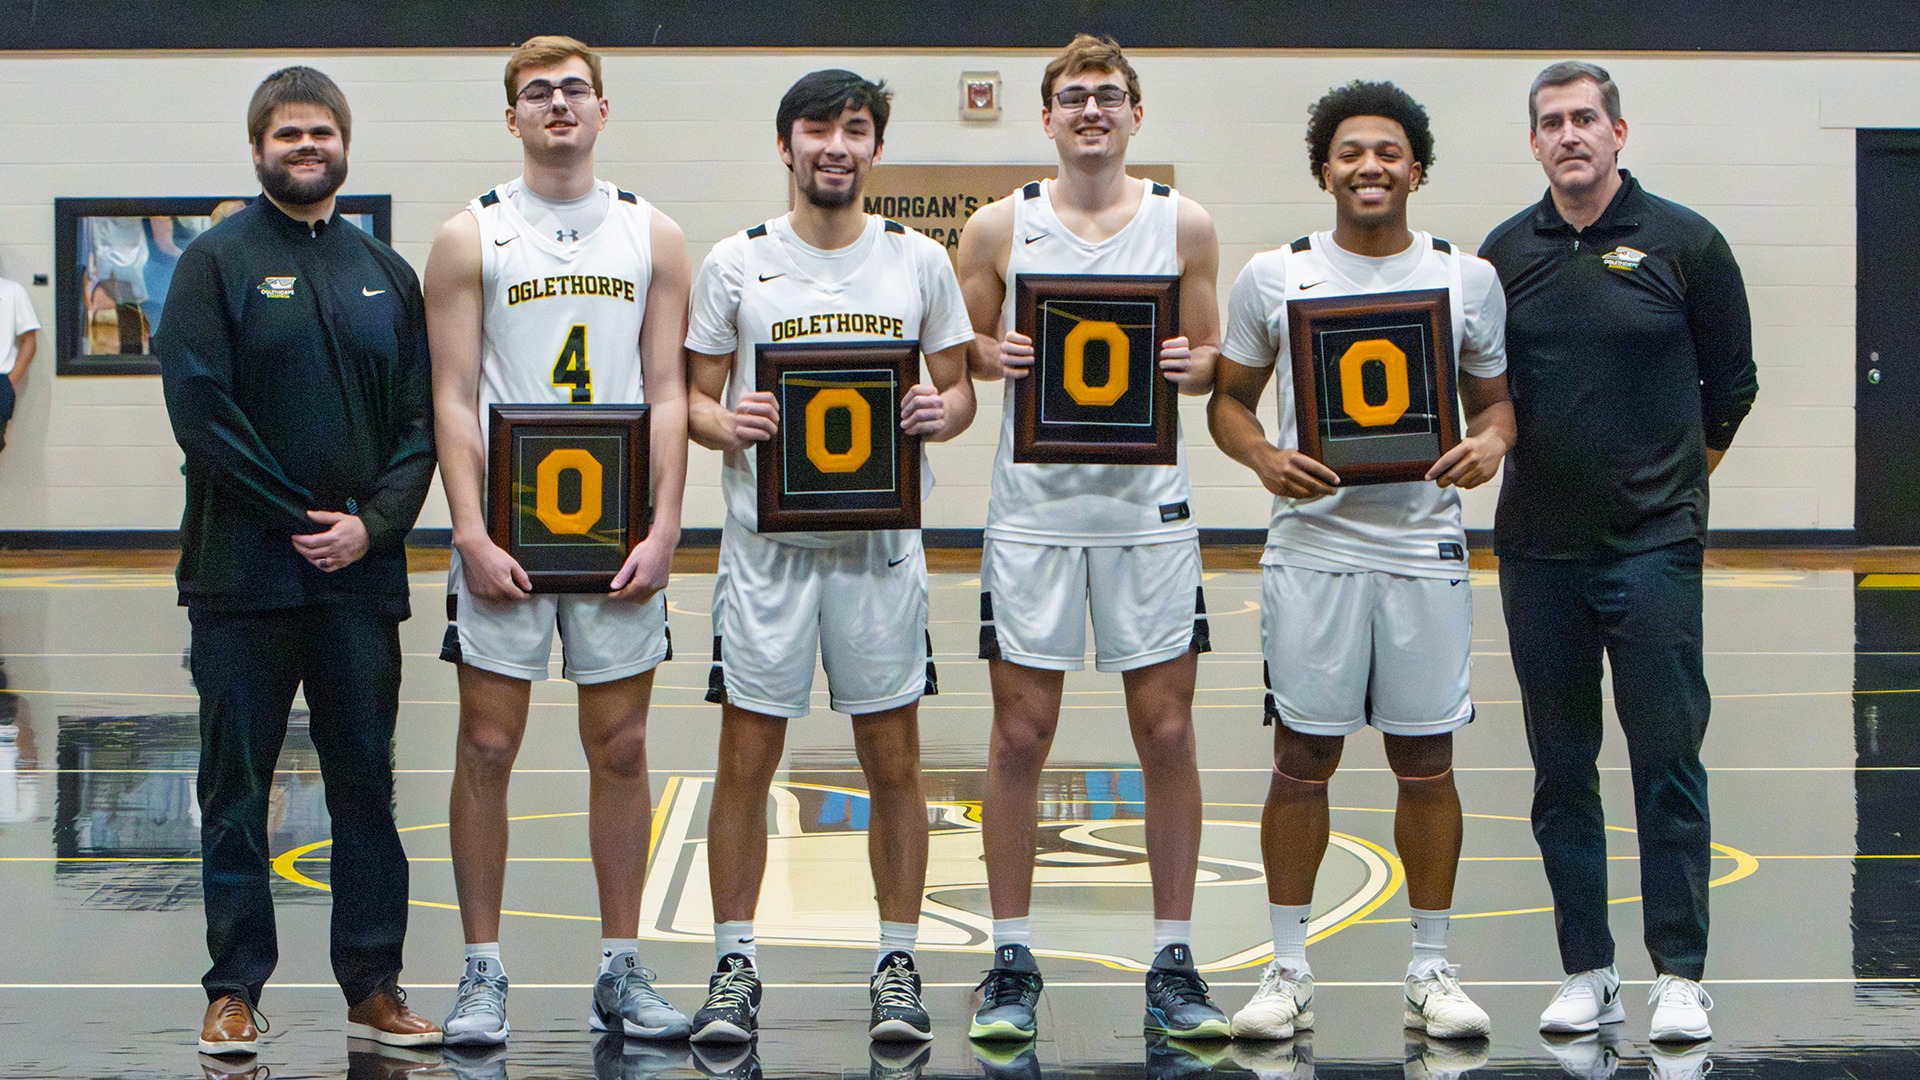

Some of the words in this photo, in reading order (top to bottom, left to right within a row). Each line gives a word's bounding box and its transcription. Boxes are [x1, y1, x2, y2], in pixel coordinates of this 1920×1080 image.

[864, 194, 978, 218] MORGAN'S
[508, 275, 635, 306] OGLETHORPE
[772, 313, 903, 342] OGLETHORPE
[551, 324, 593, 404] 4
[1063, 320, 1130, 406] O
[1339, 338, 1410, 427] O
[805, 388, 871, 473] O
[536, 448, 603, 535] O
